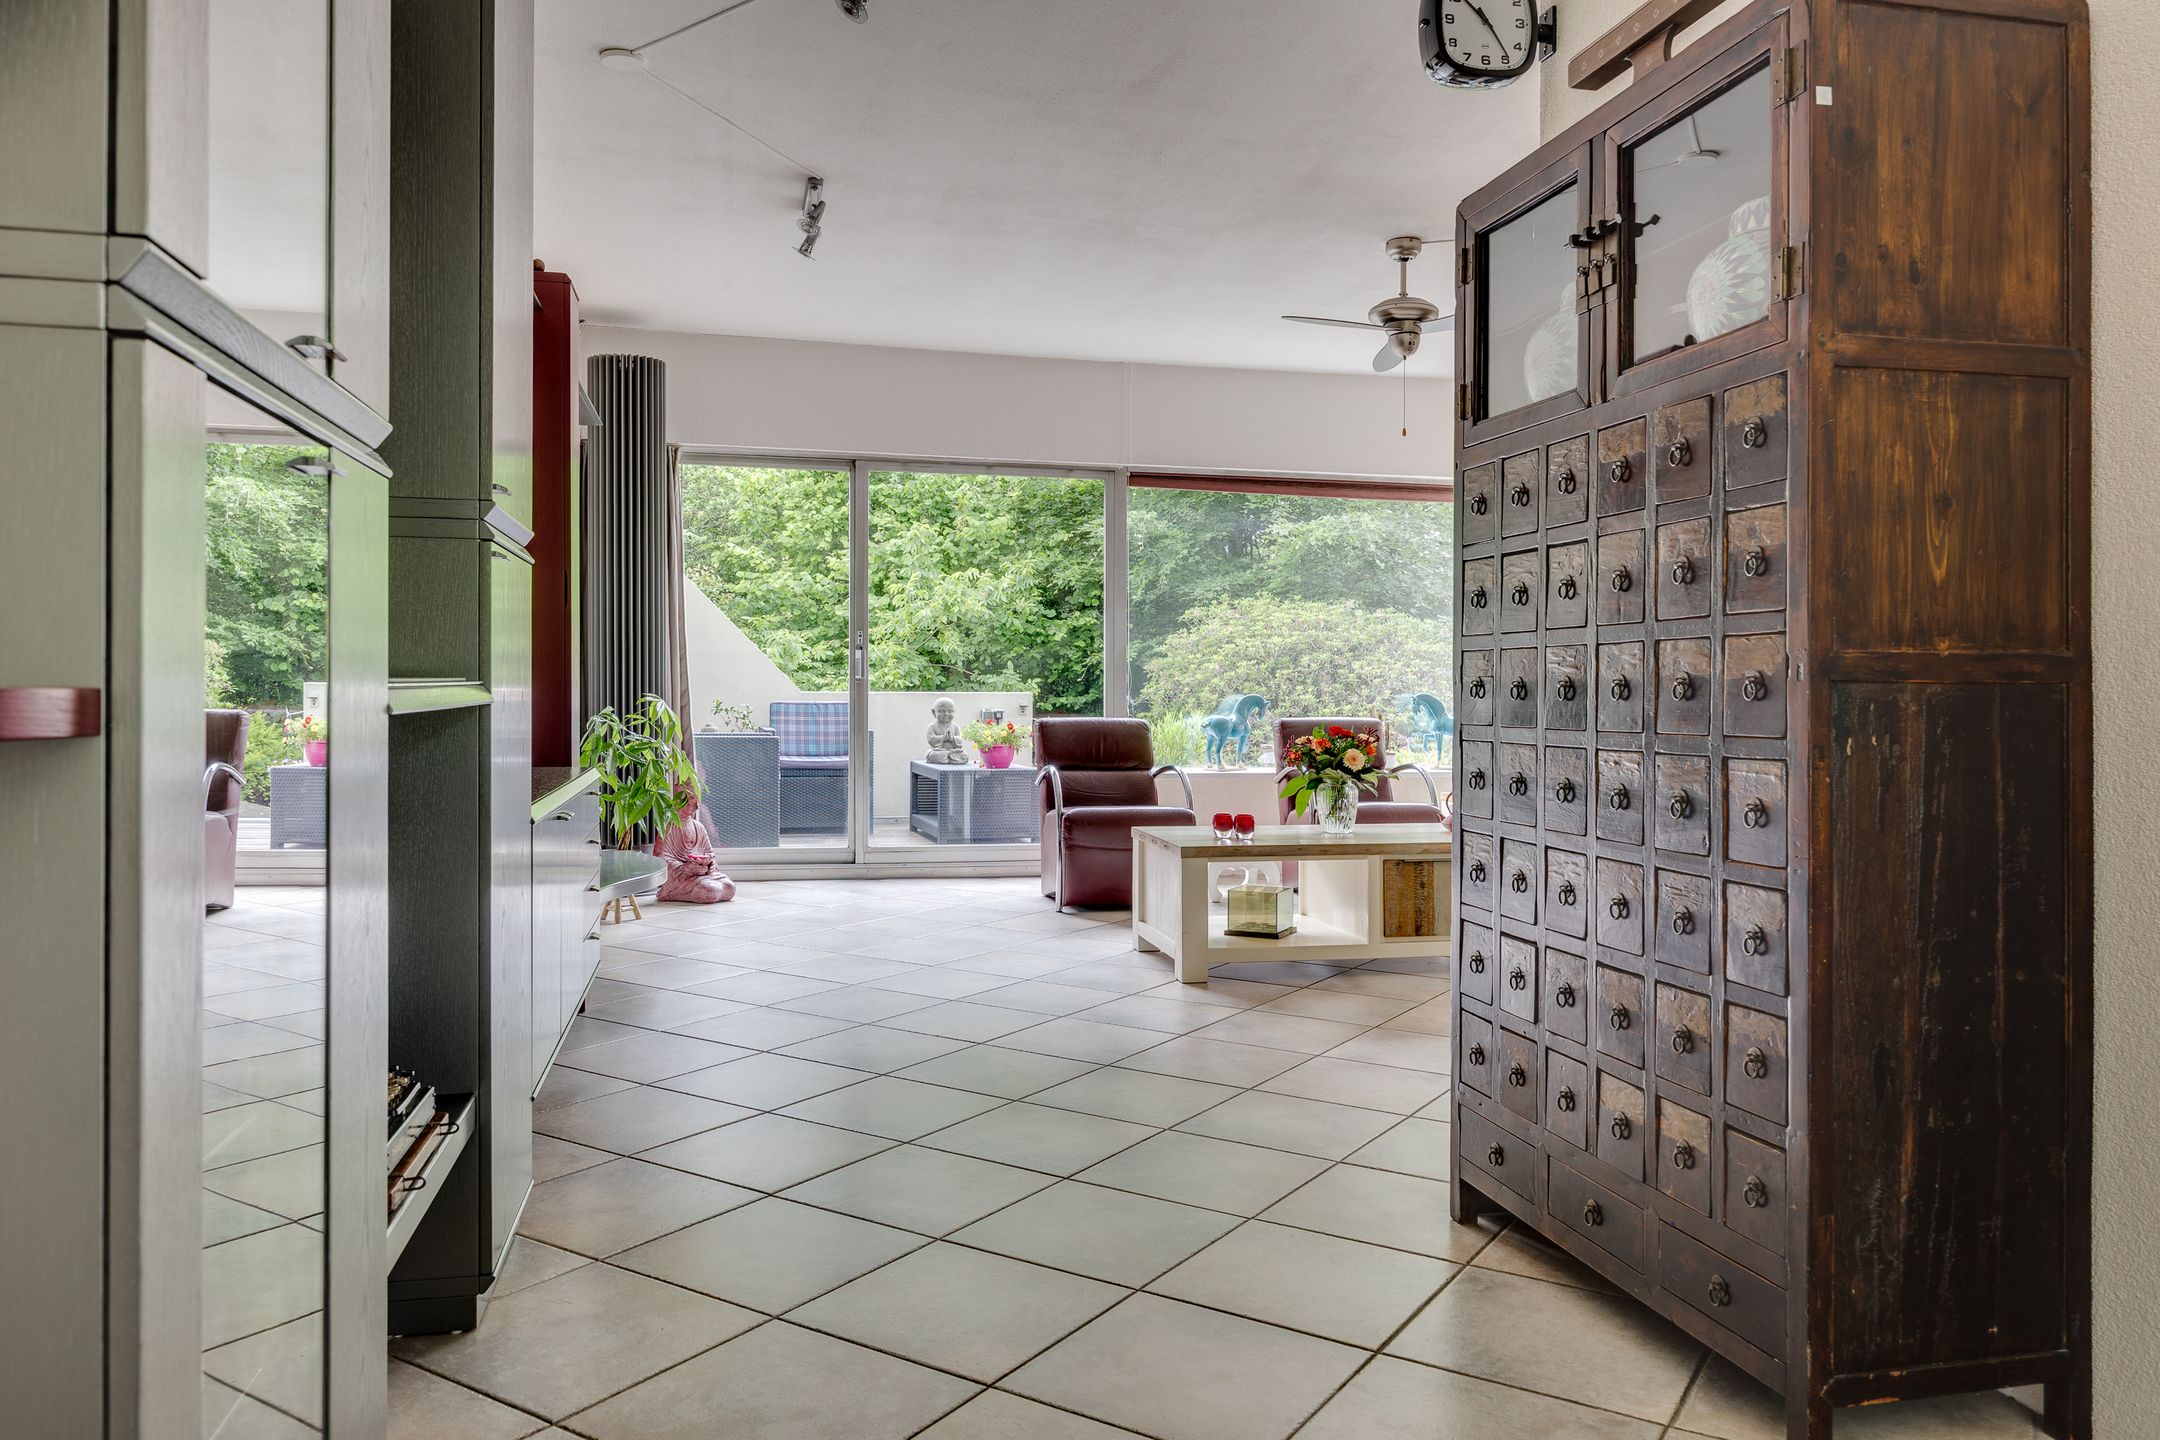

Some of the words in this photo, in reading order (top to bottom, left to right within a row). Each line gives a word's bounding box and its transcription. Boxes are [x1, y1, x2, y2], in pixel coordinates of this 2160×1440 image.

[1445, 14, 1455, 24] 9
[1515, 18, 1525, 29] 3
[1449, 38, 1458, 47] 8
[1513, 42, 1522, 52] 4
[1463, 53, 1472, 62] 7
[1481, 55, 1491, 65] 6
[1501, 55, 1510, 65] 5
